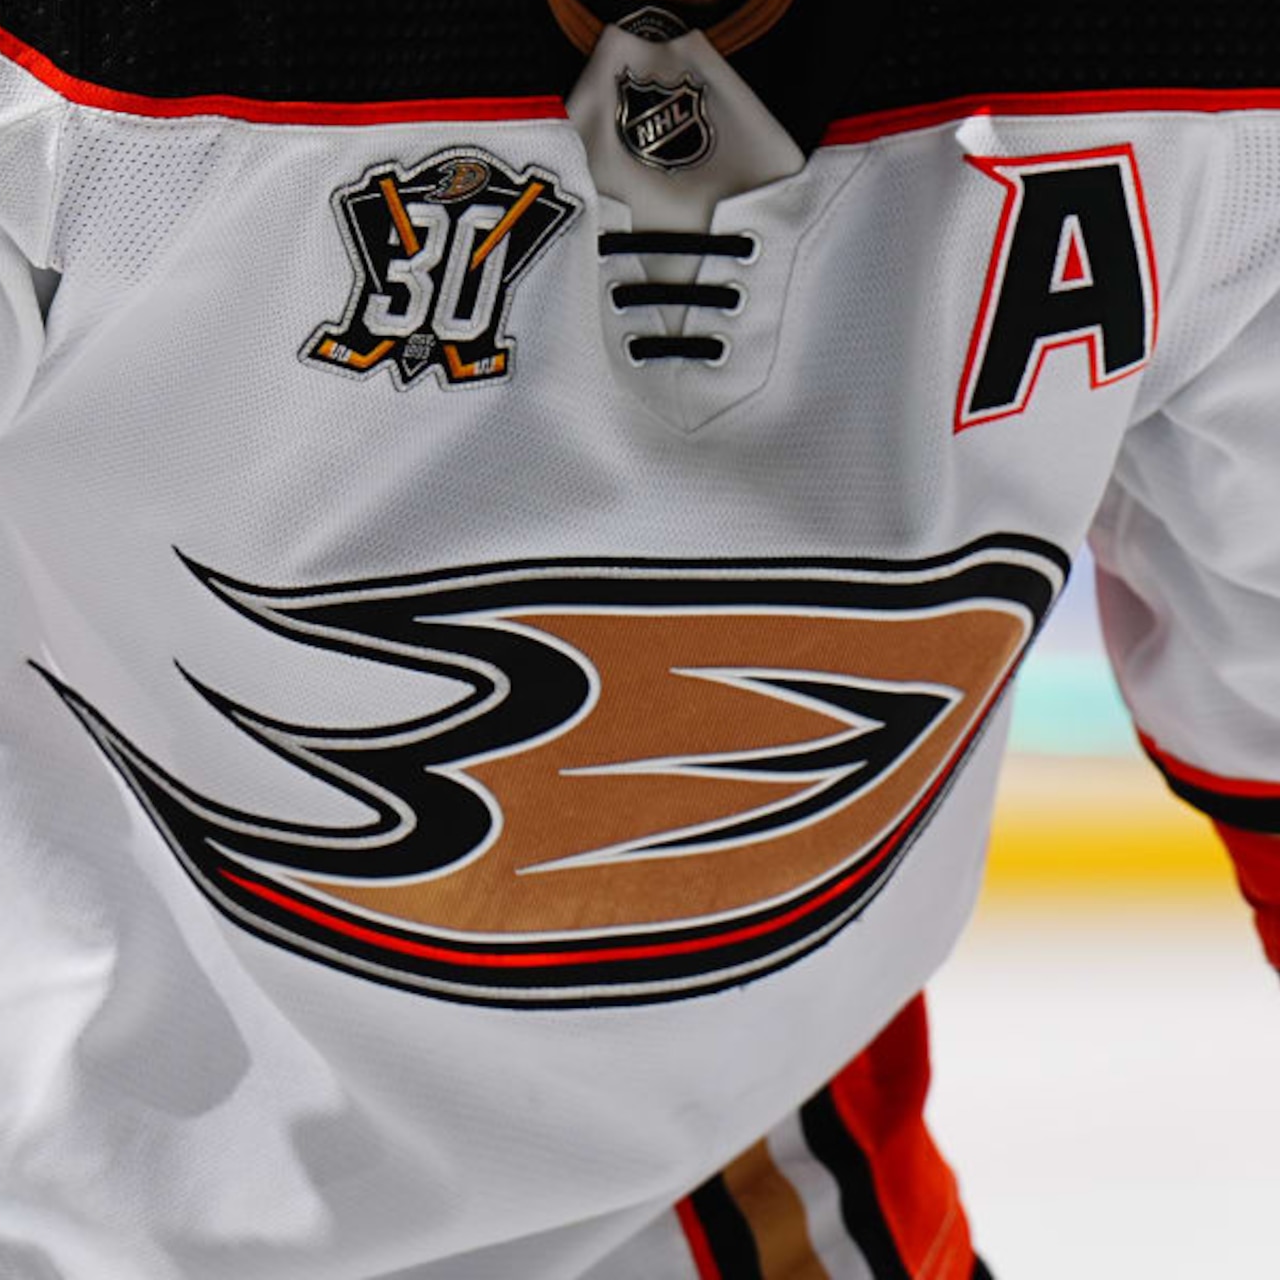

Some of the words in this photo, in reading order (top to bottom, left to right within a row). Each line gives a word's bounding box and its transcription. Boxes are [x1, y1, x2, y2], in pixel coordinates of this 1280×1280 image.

[636, 101, 690, 147] NHL
[363, 202, 511, 342] 30
[953, 142, 1161, 436] A
